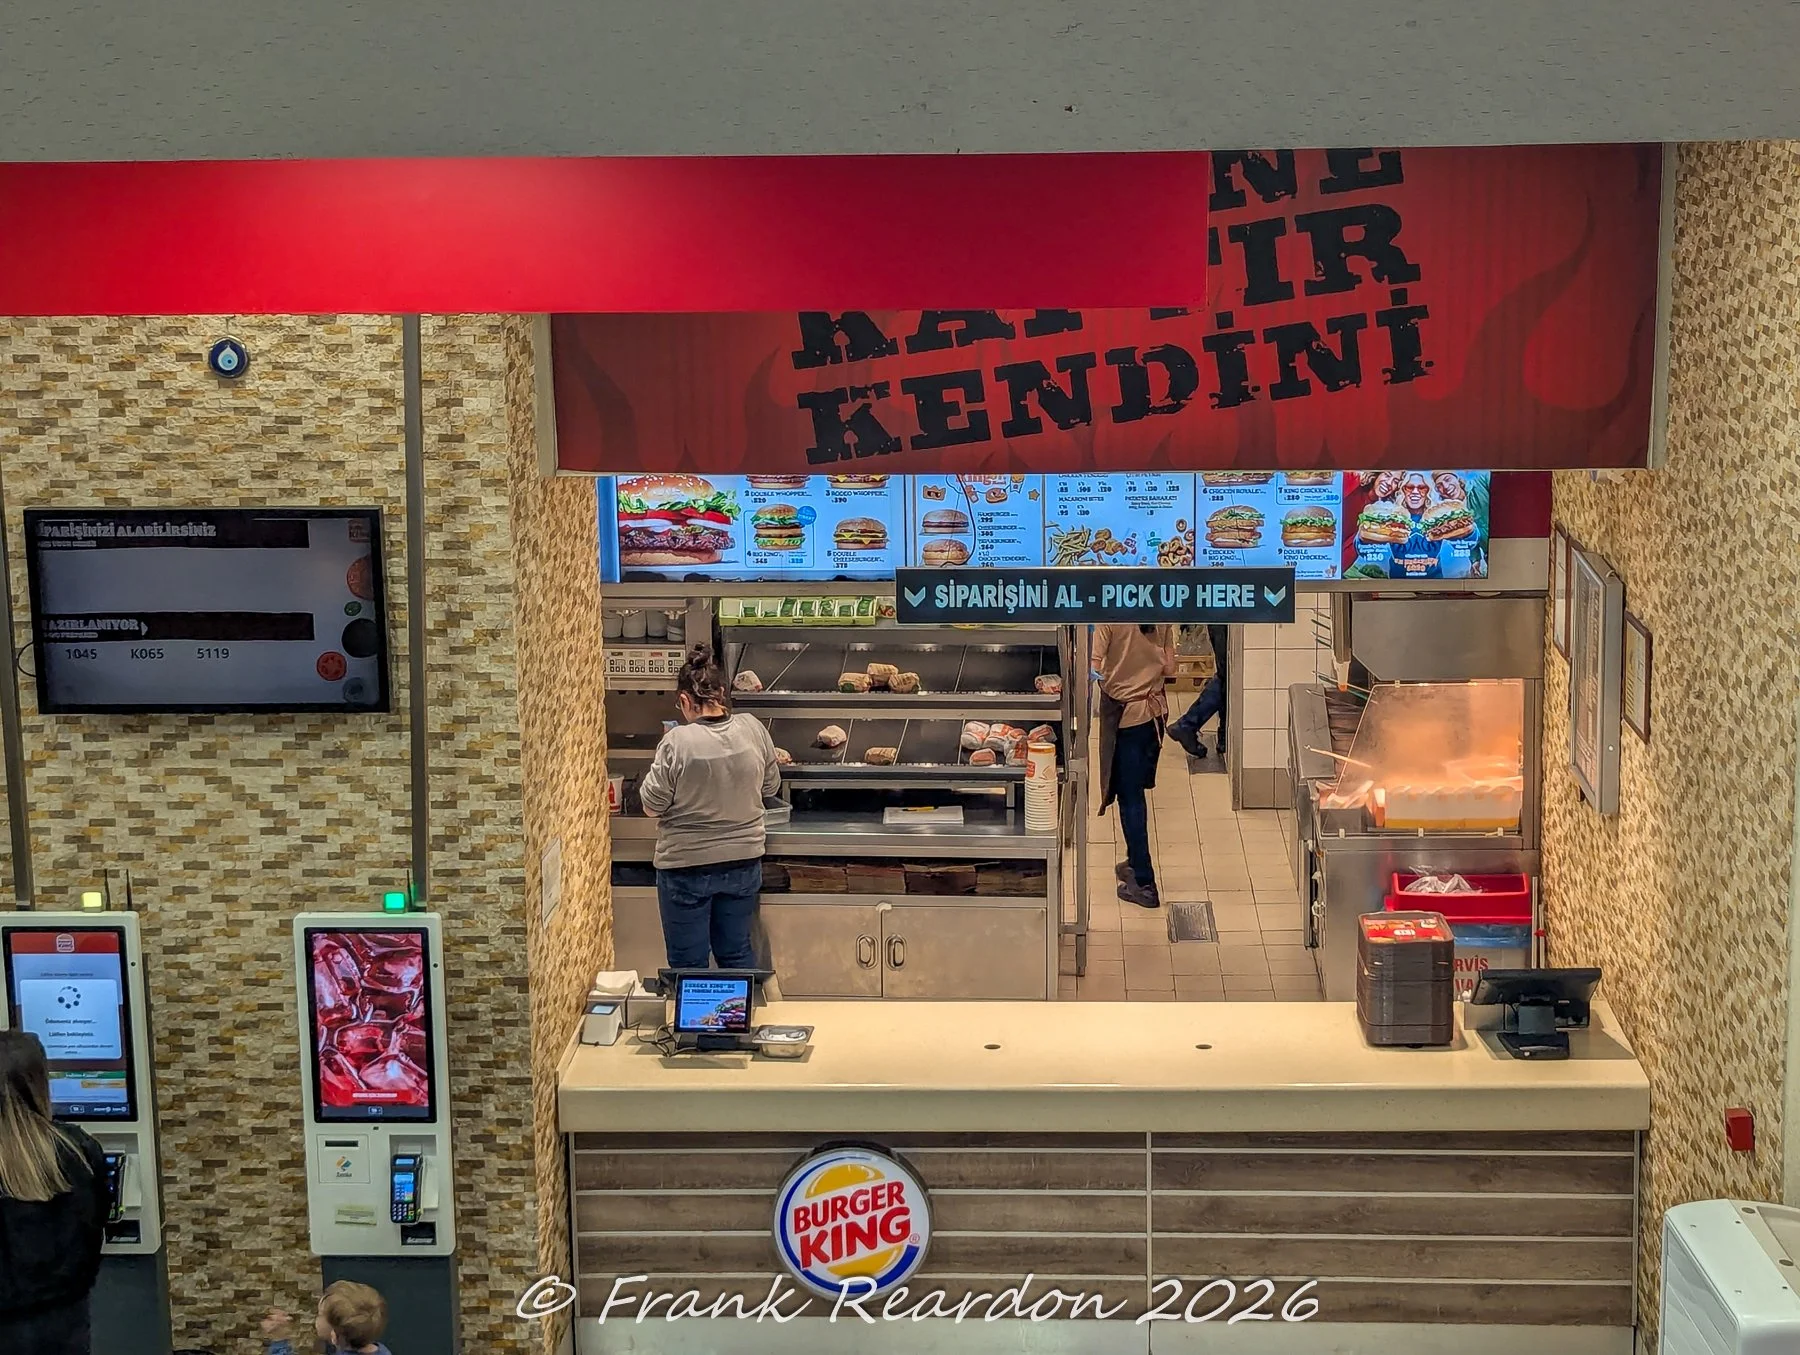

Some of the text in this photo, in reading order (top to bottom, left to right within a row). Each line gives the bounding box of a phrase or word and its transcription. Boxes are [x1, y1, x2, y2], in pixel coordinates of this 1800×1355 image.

[797, 287, 1434, 465] KENDİNİ
[935, 579, 1049, 613] SİPARİŞİNİ
[1055, 585, 1083, 608] AL
[1102, 584, 1154, 608] PICK
[1161, 584, 1190, 608] UP
[1197, 584, 1255, 608] HERE
[67, 647, 230, 660] 1045 K065 5119
[793, 1181, 906, 1235] BURGER
[799, 1206, 911, 1269] KING
